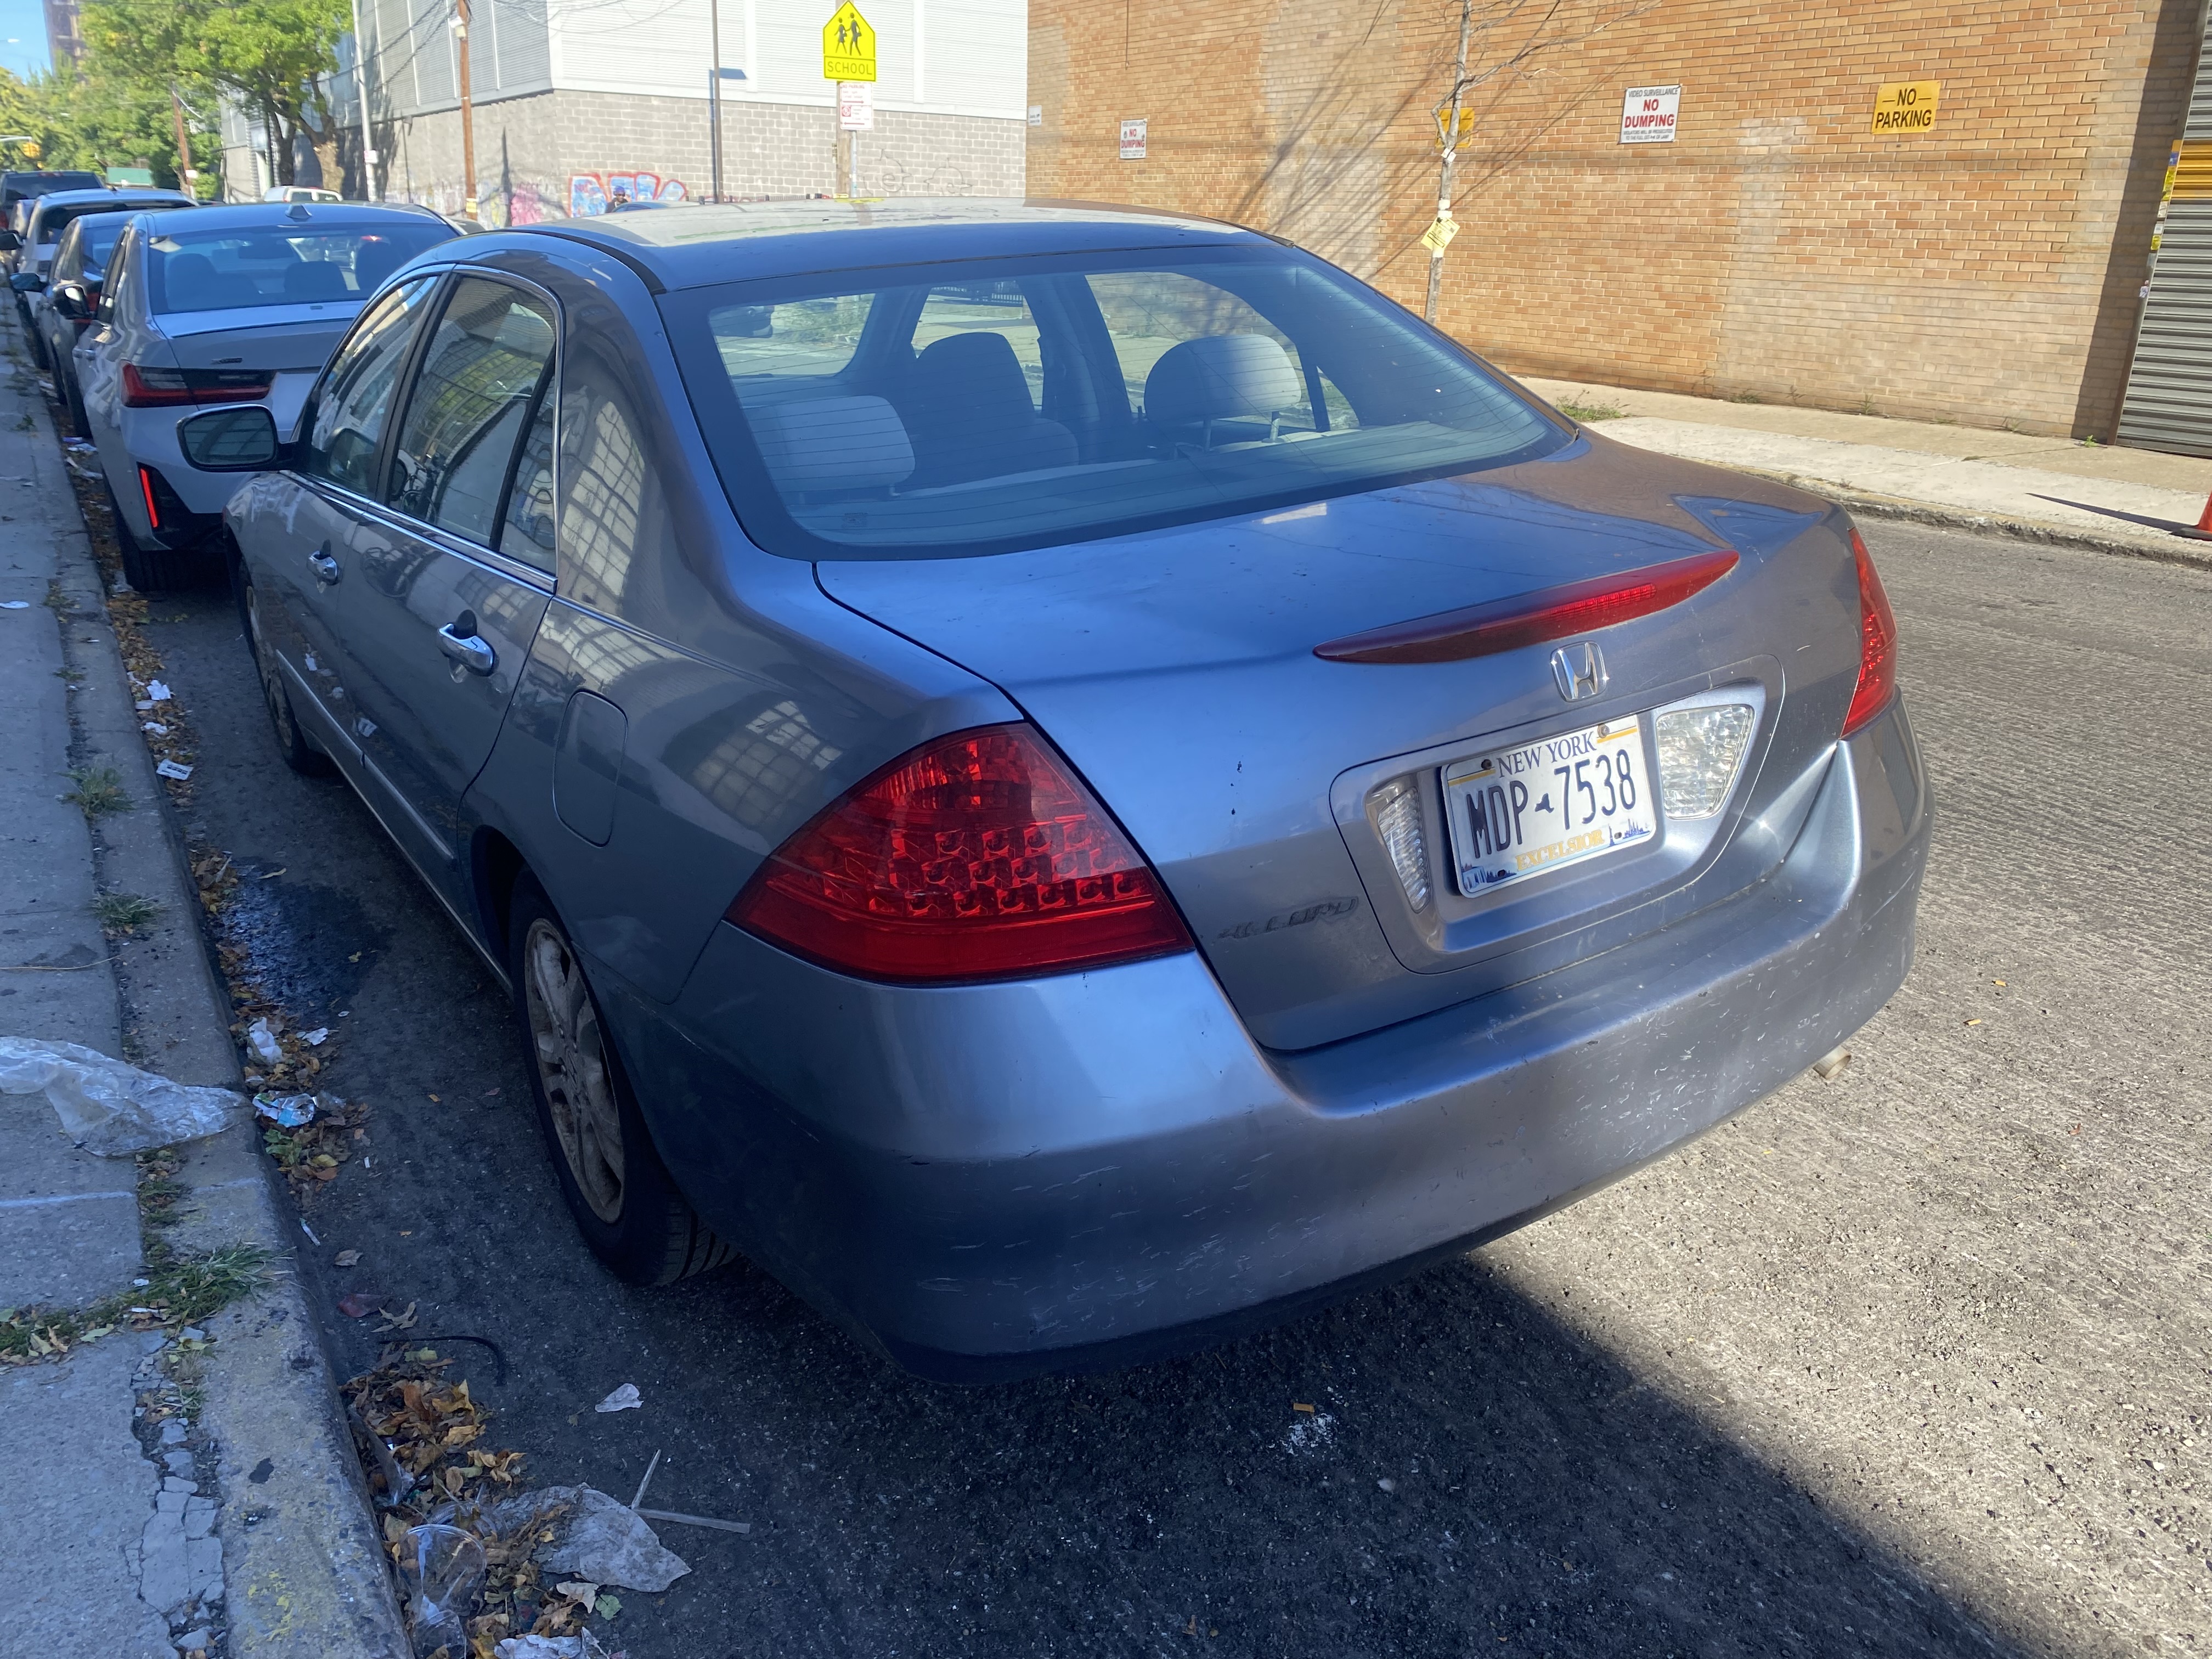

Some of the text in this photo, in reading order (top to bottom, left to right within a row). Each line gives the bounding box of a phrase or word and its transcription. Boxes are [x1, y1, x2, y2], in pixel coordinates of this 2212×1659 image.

[827, 61, 872, 75] SCHOOL
[1628, 87, 1678, 98] VIDEO SURVEILLANCE
[1897, 88, 1917, 106] NO
[1643, 98, 1659, 111] NO
[1624, 114, 1675, 128] DUMPING
[1875, 109, 1932, 129] PARKING
[1129, 128, 1137, 137] NO
[1121, 139, 1145, 149] DUMPING
[1496, 731, 1597, 778] NEW YORK
[1466, 748, 1637, 860] MDP 7538
[1515, 828, 1605, 872] EXCELSIOR
